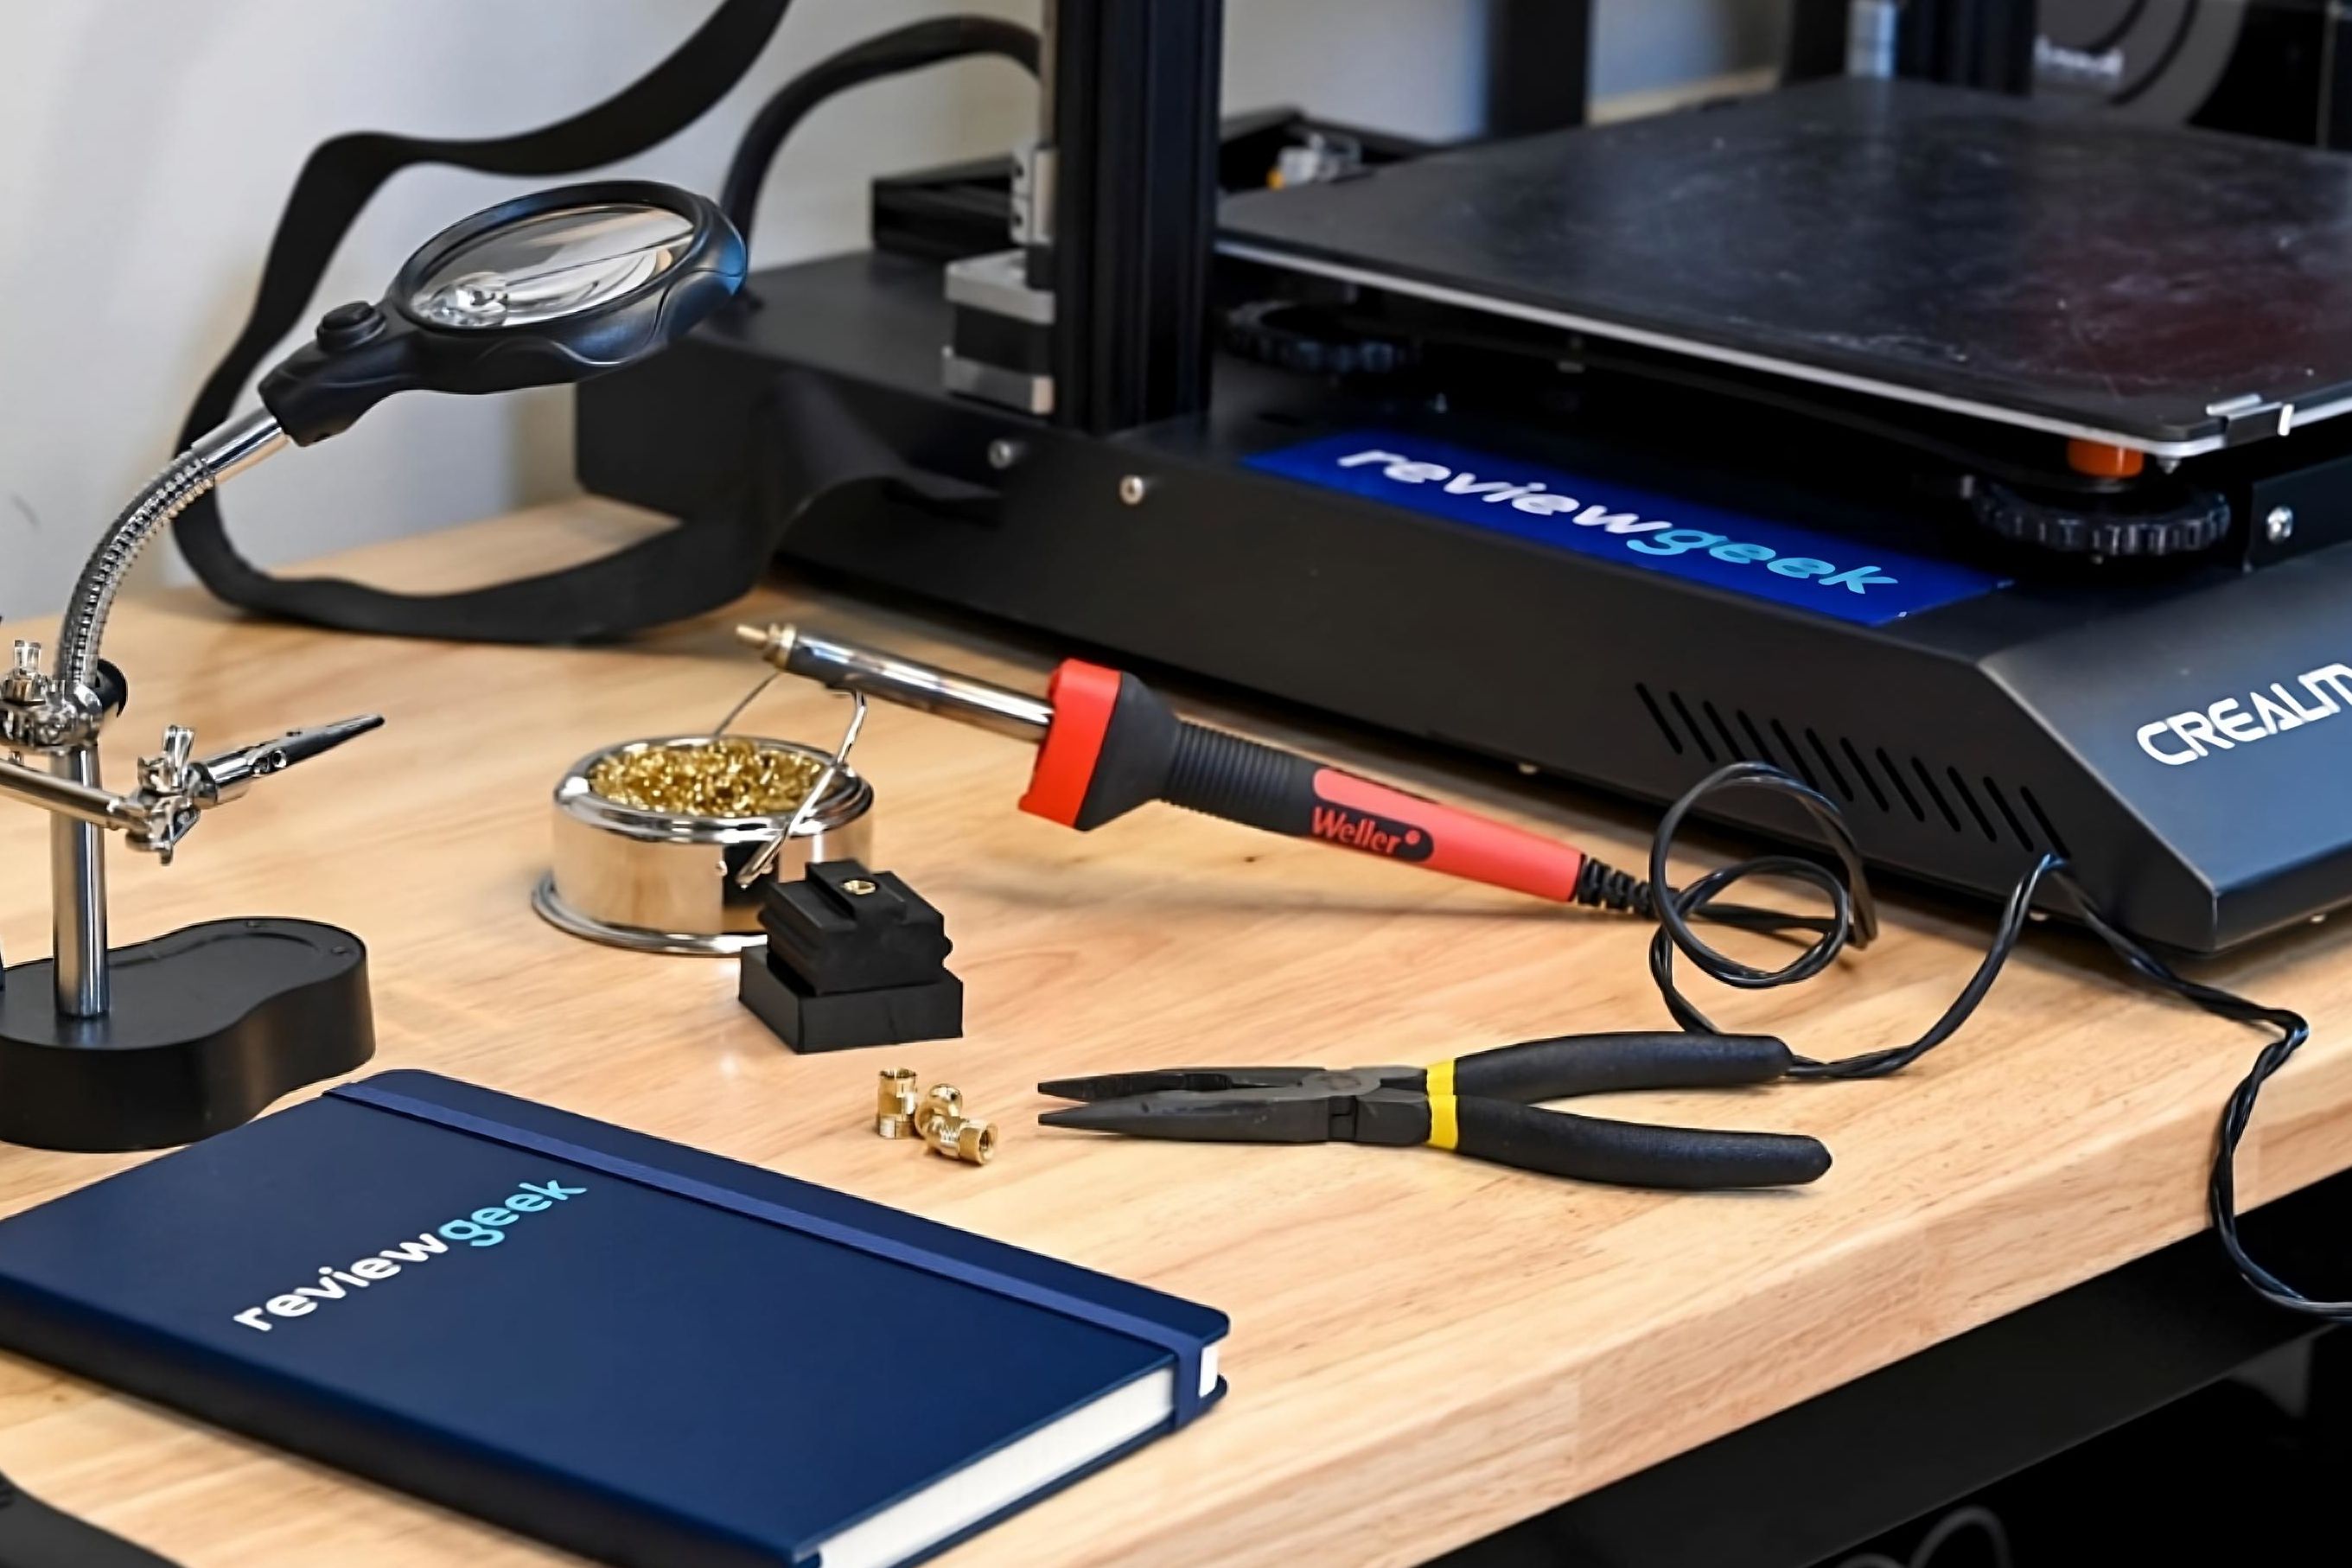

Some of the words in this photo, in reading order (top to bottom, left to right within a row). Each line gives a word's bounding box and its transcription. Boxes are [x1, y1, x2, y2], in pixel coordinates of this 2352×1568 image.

[1337, 449, 1899, 595] reviewgeek
[1312, 806, 1402, 854] Weller
[233, 1179, 588, 1332] reviewgeek
